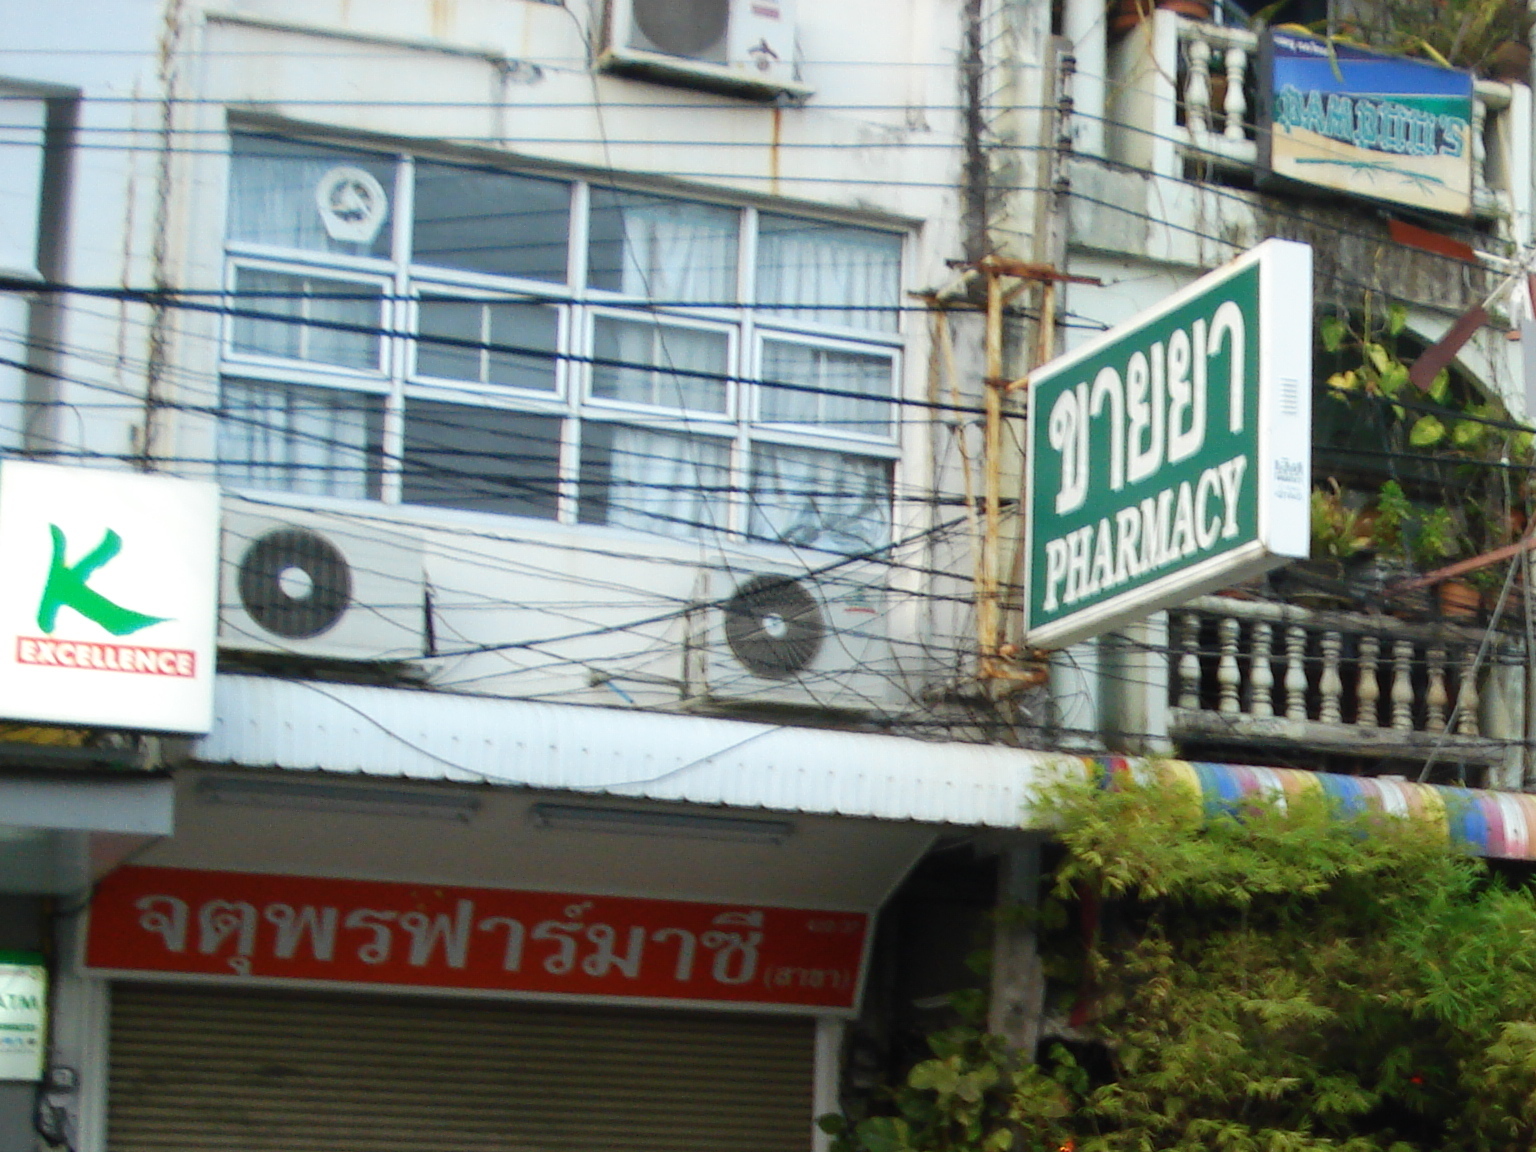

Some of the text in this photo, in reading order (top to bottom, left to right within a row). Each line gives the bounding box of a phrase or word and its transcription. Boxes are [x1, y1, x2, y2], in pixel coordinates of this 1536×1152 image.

[1049, 300, 1246, 516] ขายยา
[36, 522, 178, 637] K
[1043, 454, 1248, 613] PHARMACY
[19, 639, 193, 676] EXCELLENCE
[135, 893, 765, 986] จตุพรฟาร์มาซี
